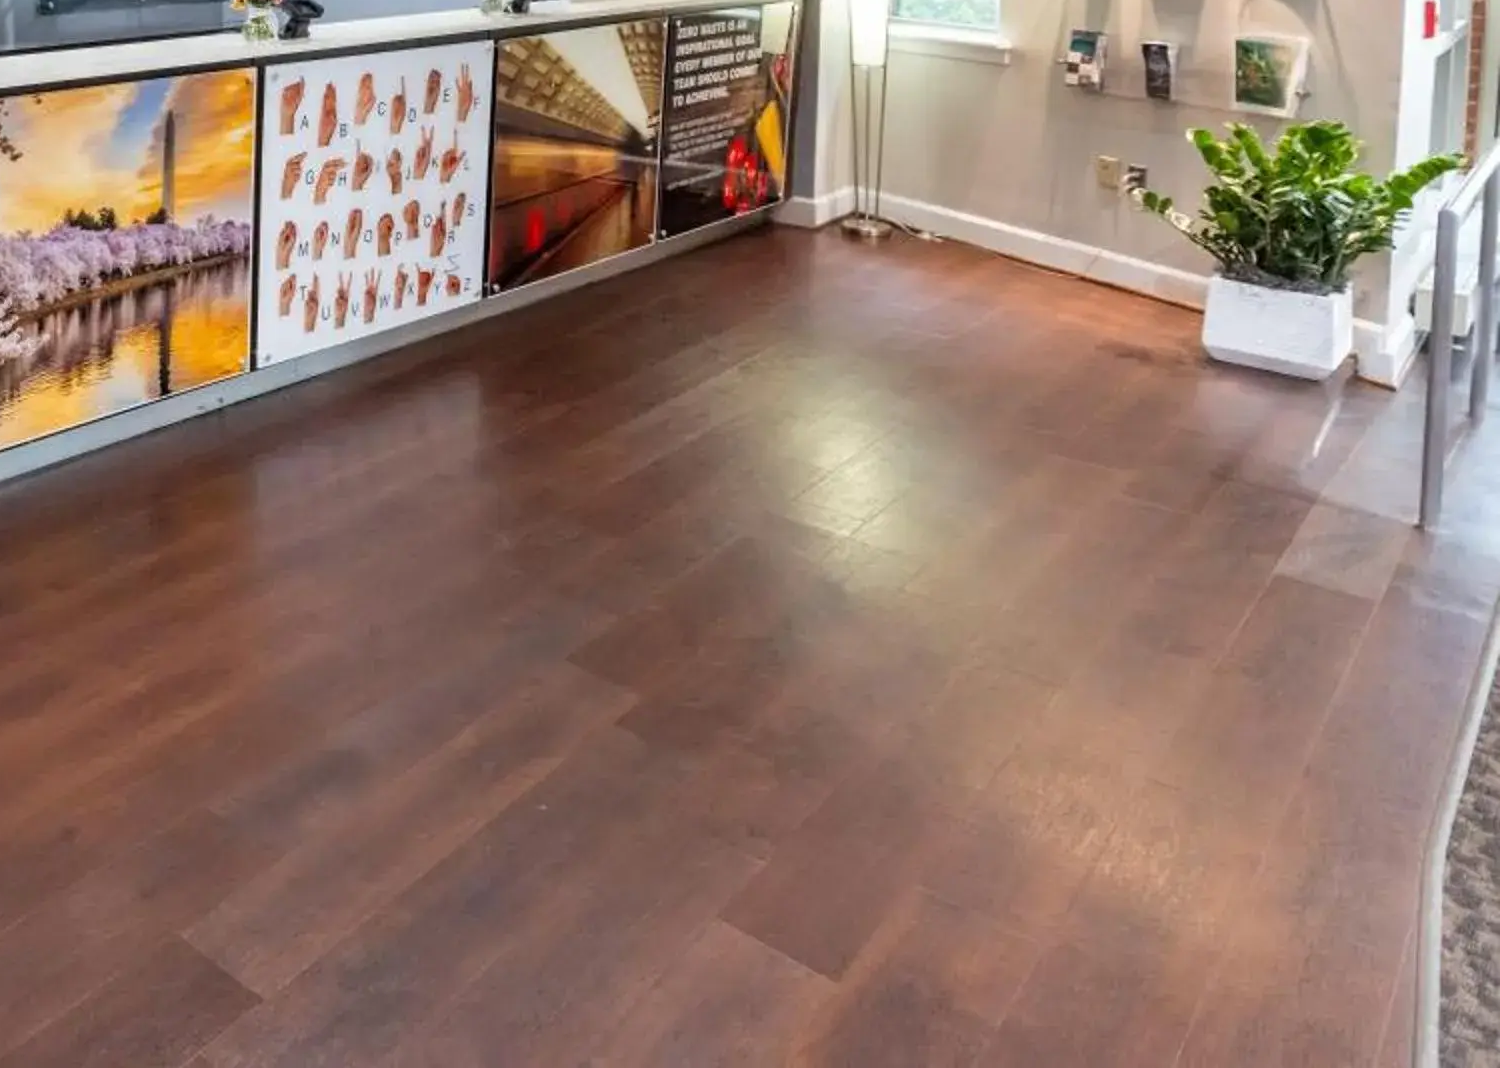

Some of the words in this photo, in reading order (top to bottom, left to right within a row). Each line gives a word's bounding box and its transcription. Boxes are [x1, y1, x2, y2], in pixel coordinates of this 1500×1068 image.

[300, 114, 309, 131] A
[338, 123, 348, 138] B
[377, 101, 387, 117] C
[408, 107, 417, 123] D
[443, 87, 452, 103] E
[305, 169, 315, 185] G
[338, 173, 347, 187] H
[431, 154, 439, 169] K
[298, 240, 309, 257] M
[331, 232, 340, 245] N
[395, 231, 403, 246] P
[447, 230, 455, 244] R
[300, 284, 308, 301] T
[321, 305, 331, 321] U
[351, 302, 360, 317] V
[380, 293, 391, 309] W
